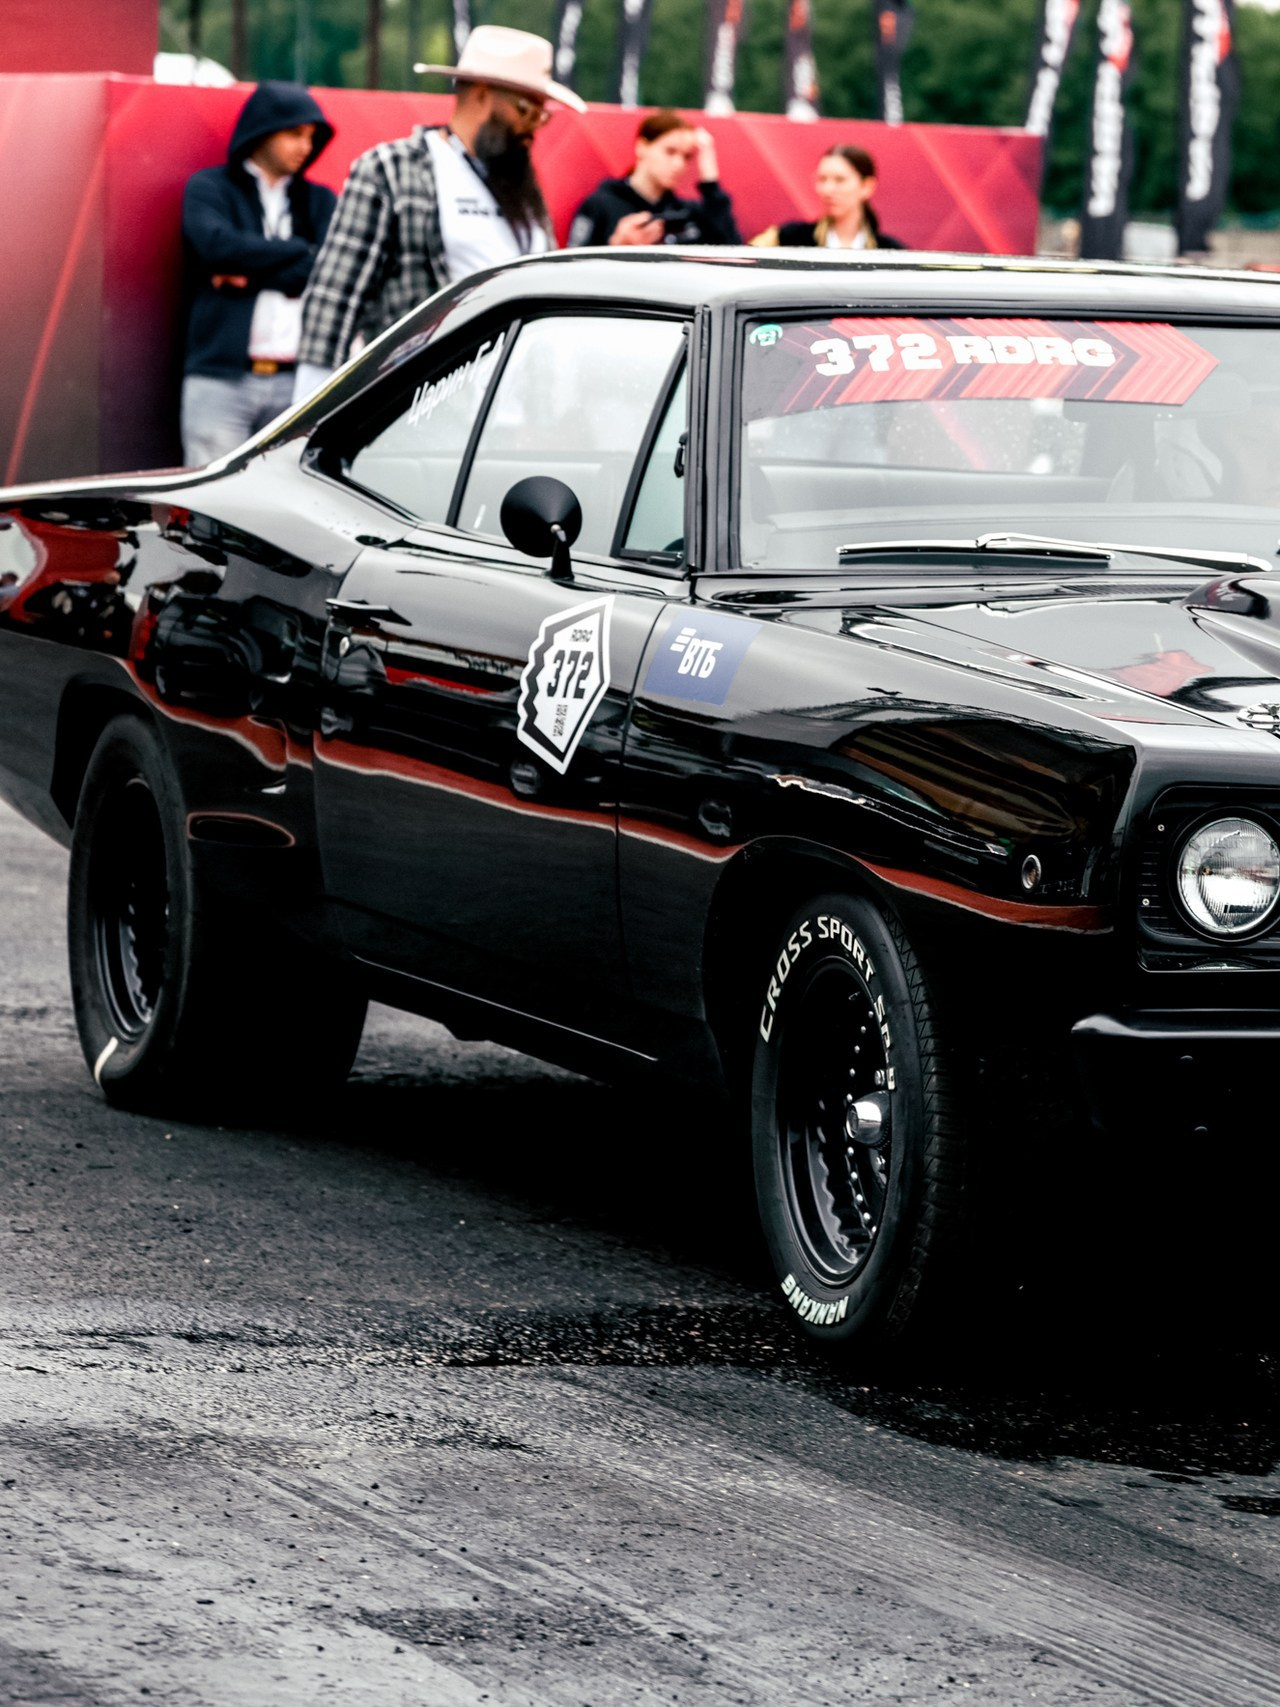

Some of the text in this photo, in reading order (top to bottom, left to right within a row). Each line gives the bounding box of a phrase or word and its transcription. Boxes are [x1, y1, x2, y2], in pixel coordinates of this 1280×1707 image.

[810, 333, 943, 376] 372
[547, 650, 594, 699] 372
[677, 637, 724, 679] ВТБ
[760, 921, 812, 1043] CROSS
[817, 916, 874, 981] SPORT
[781, 1274, 849, 1325] NANKANG
